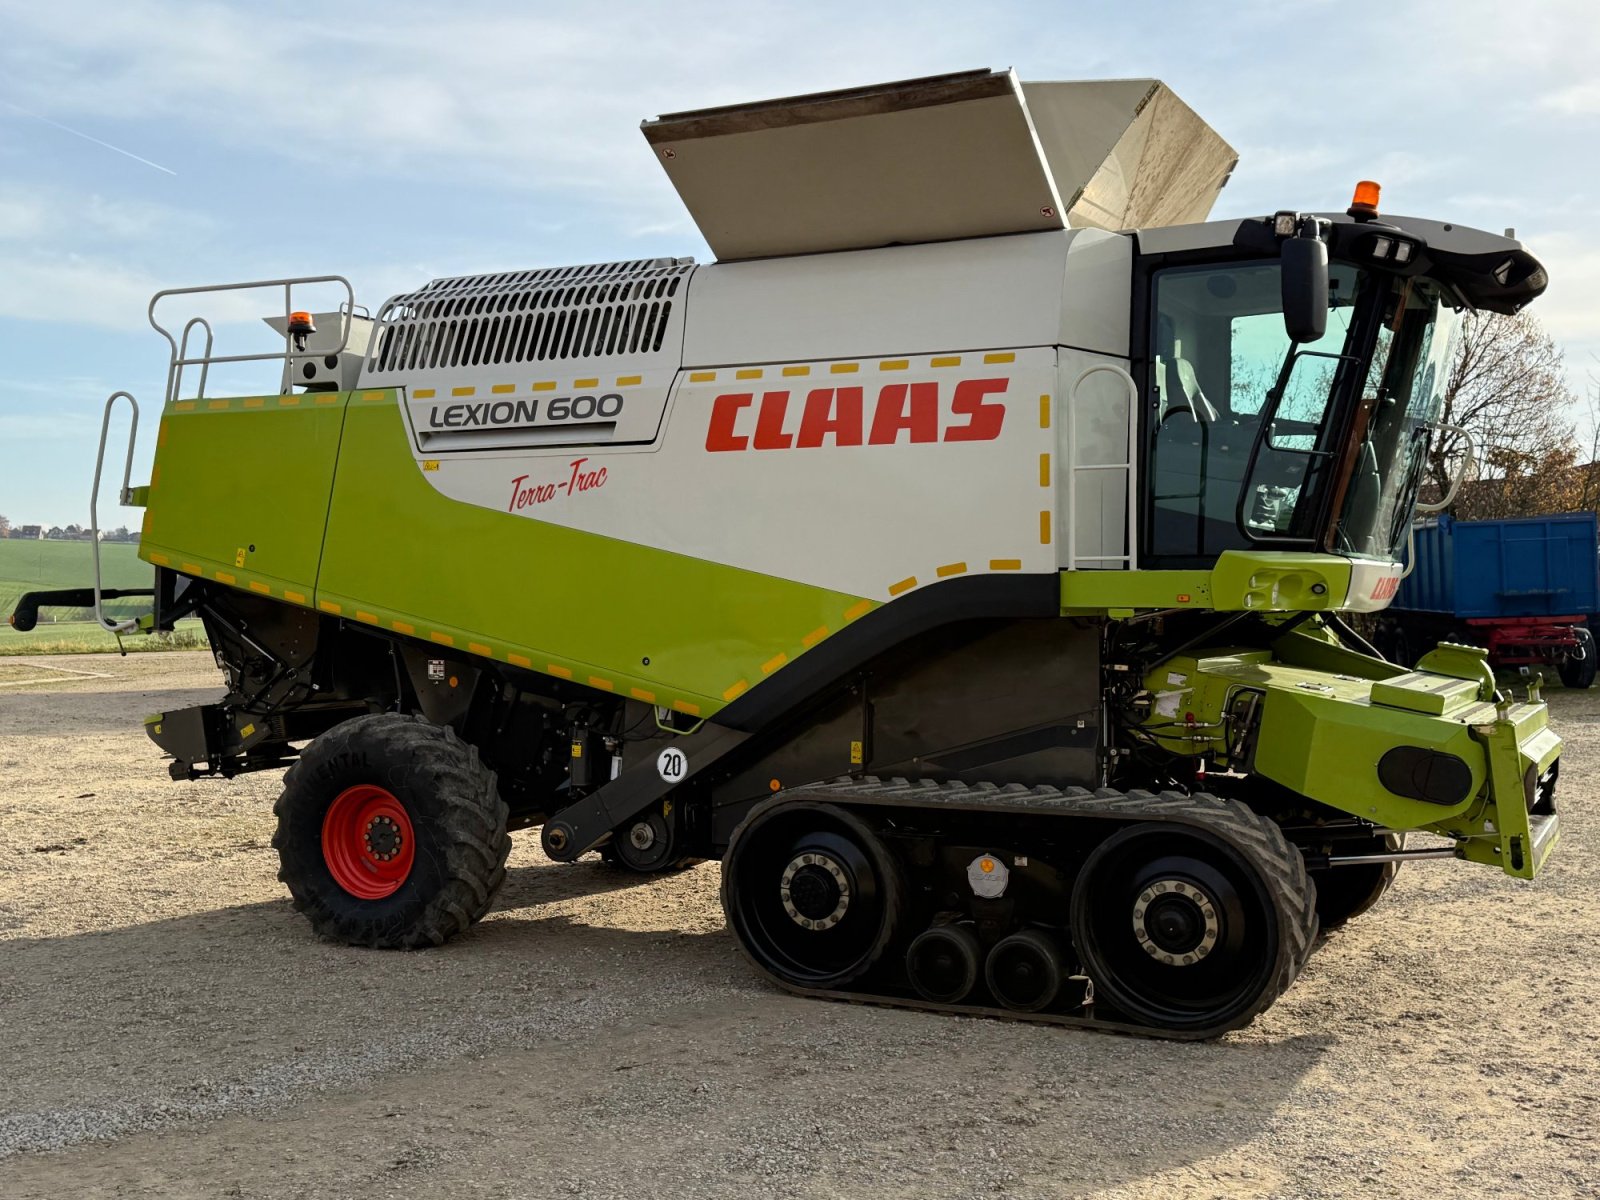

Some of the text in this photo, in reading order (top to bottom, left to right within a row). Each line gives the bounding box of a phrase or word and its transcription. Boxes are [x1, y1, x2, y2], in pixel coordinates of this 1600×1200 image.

[430, 394, 623, 429] LEXION 600
[706, 378, 1010, 452] CLAAS
[509, 458, 608, 513] Terra-Trac
[663, 753, 681, 777] 20
